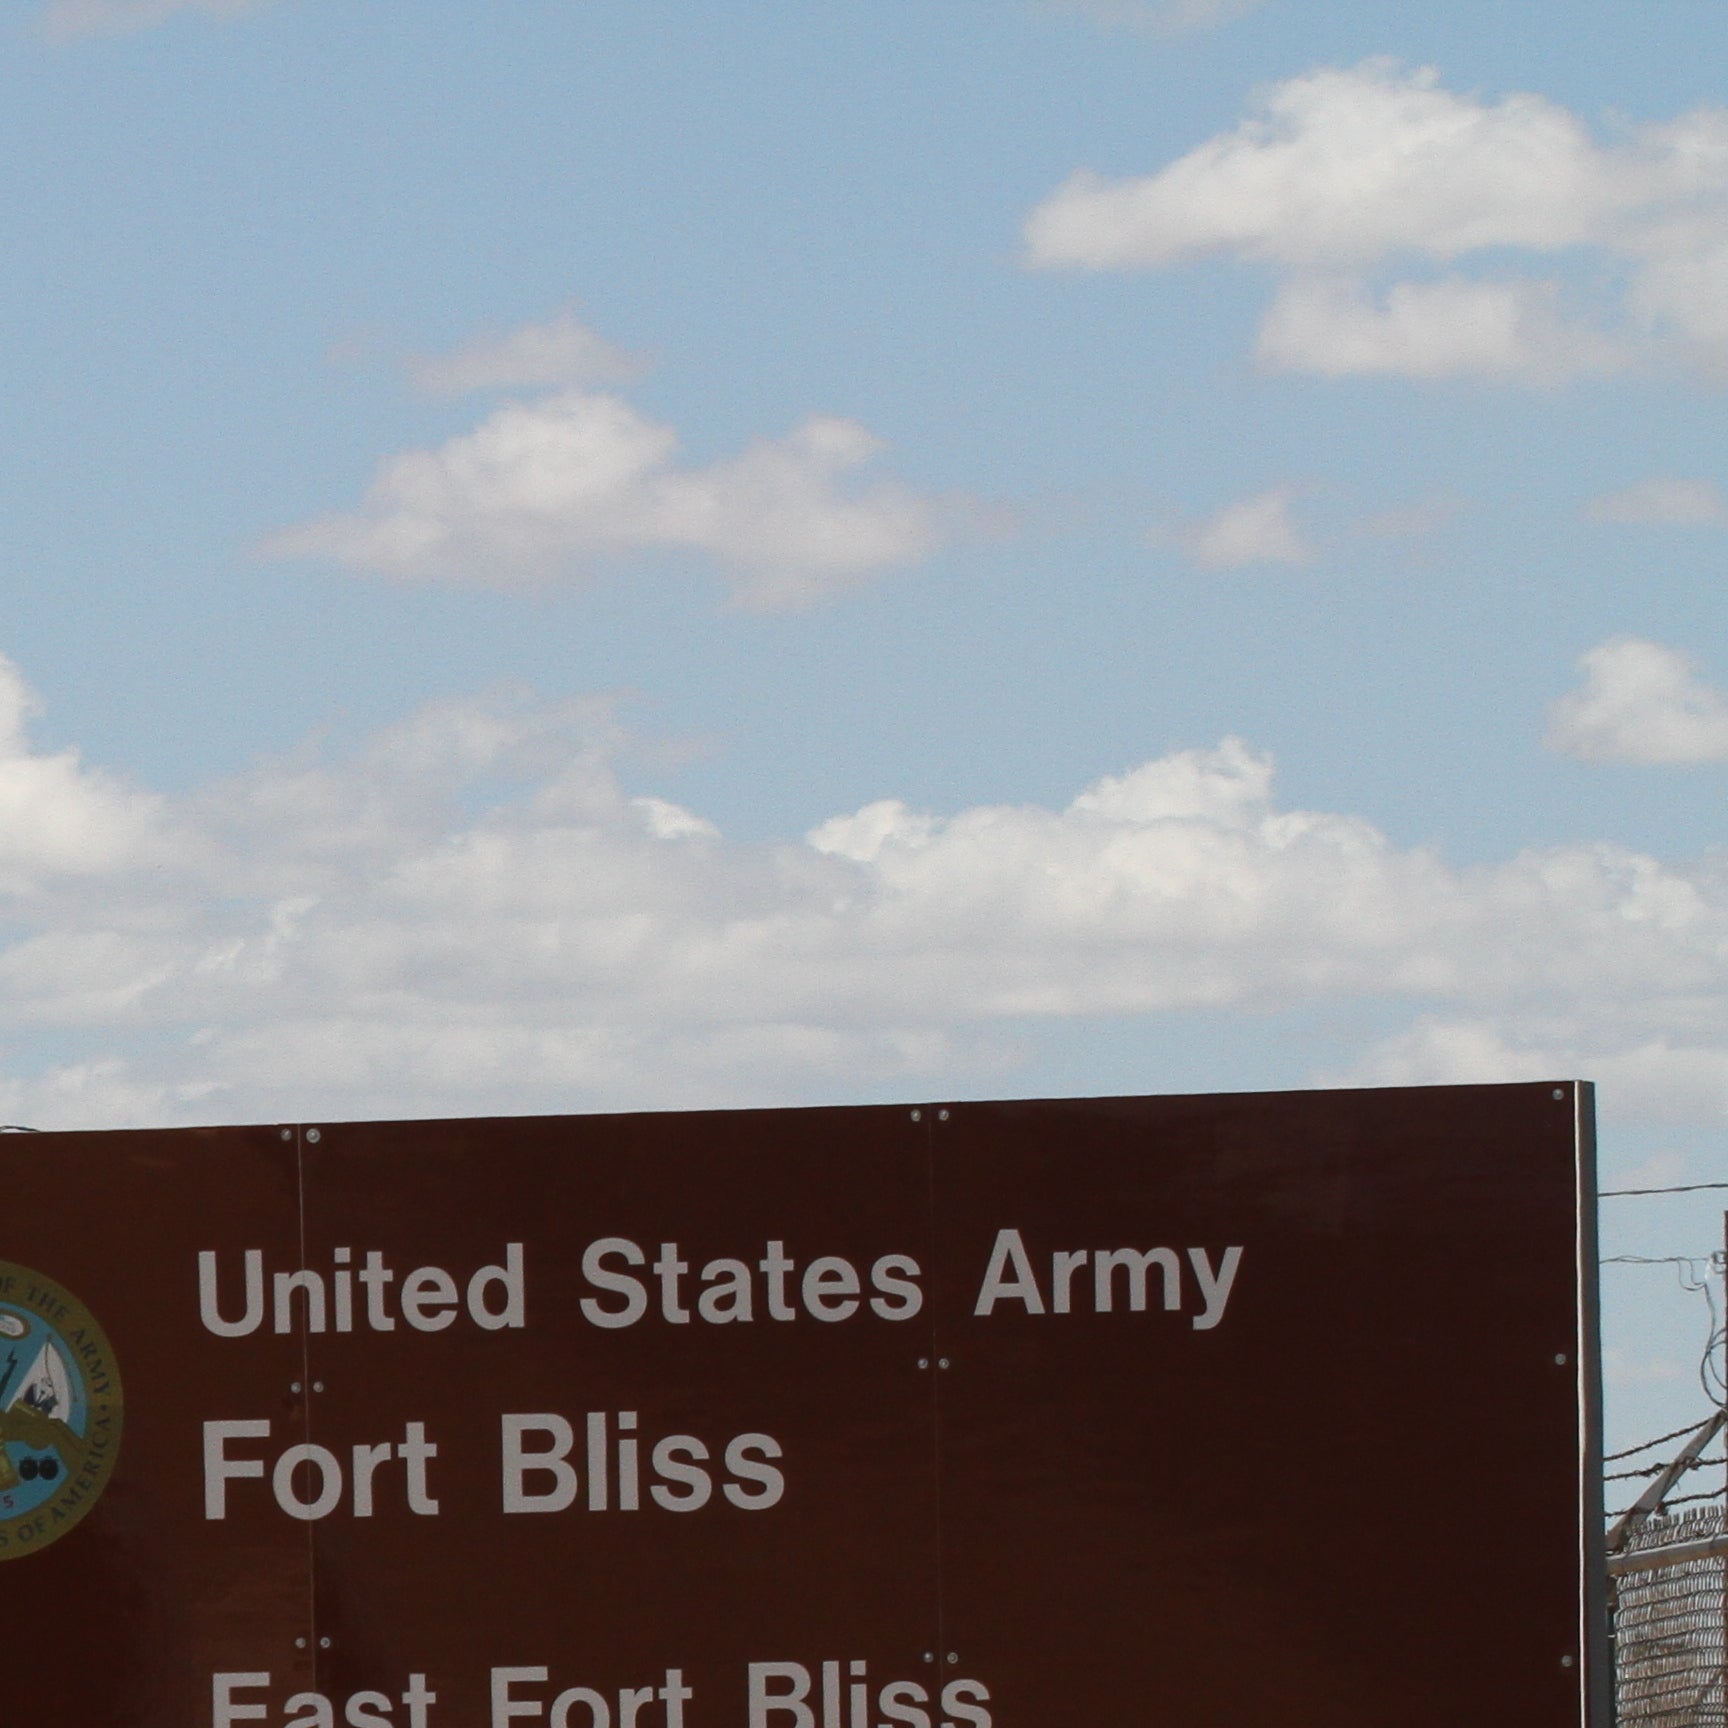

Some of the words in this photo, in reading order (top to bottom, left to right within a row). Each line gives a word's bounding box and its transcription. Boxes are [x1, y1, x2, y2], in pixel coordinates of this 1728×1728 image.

[198, 1242, 525, 1337] United
[580, 1237, 923, 1329] States
[974, 1229, 1243, 1330] Army
[27, 1286, 68, 1322] THE
[71, 1328, 111, 1394] ARMY
[17, 1519, 47, 1542] OF
[51, 1417, 112, 1526] AMERICA
[203, 1419, 439, 1520] Fort
[501, 1411, 785, 1514] Bliss
